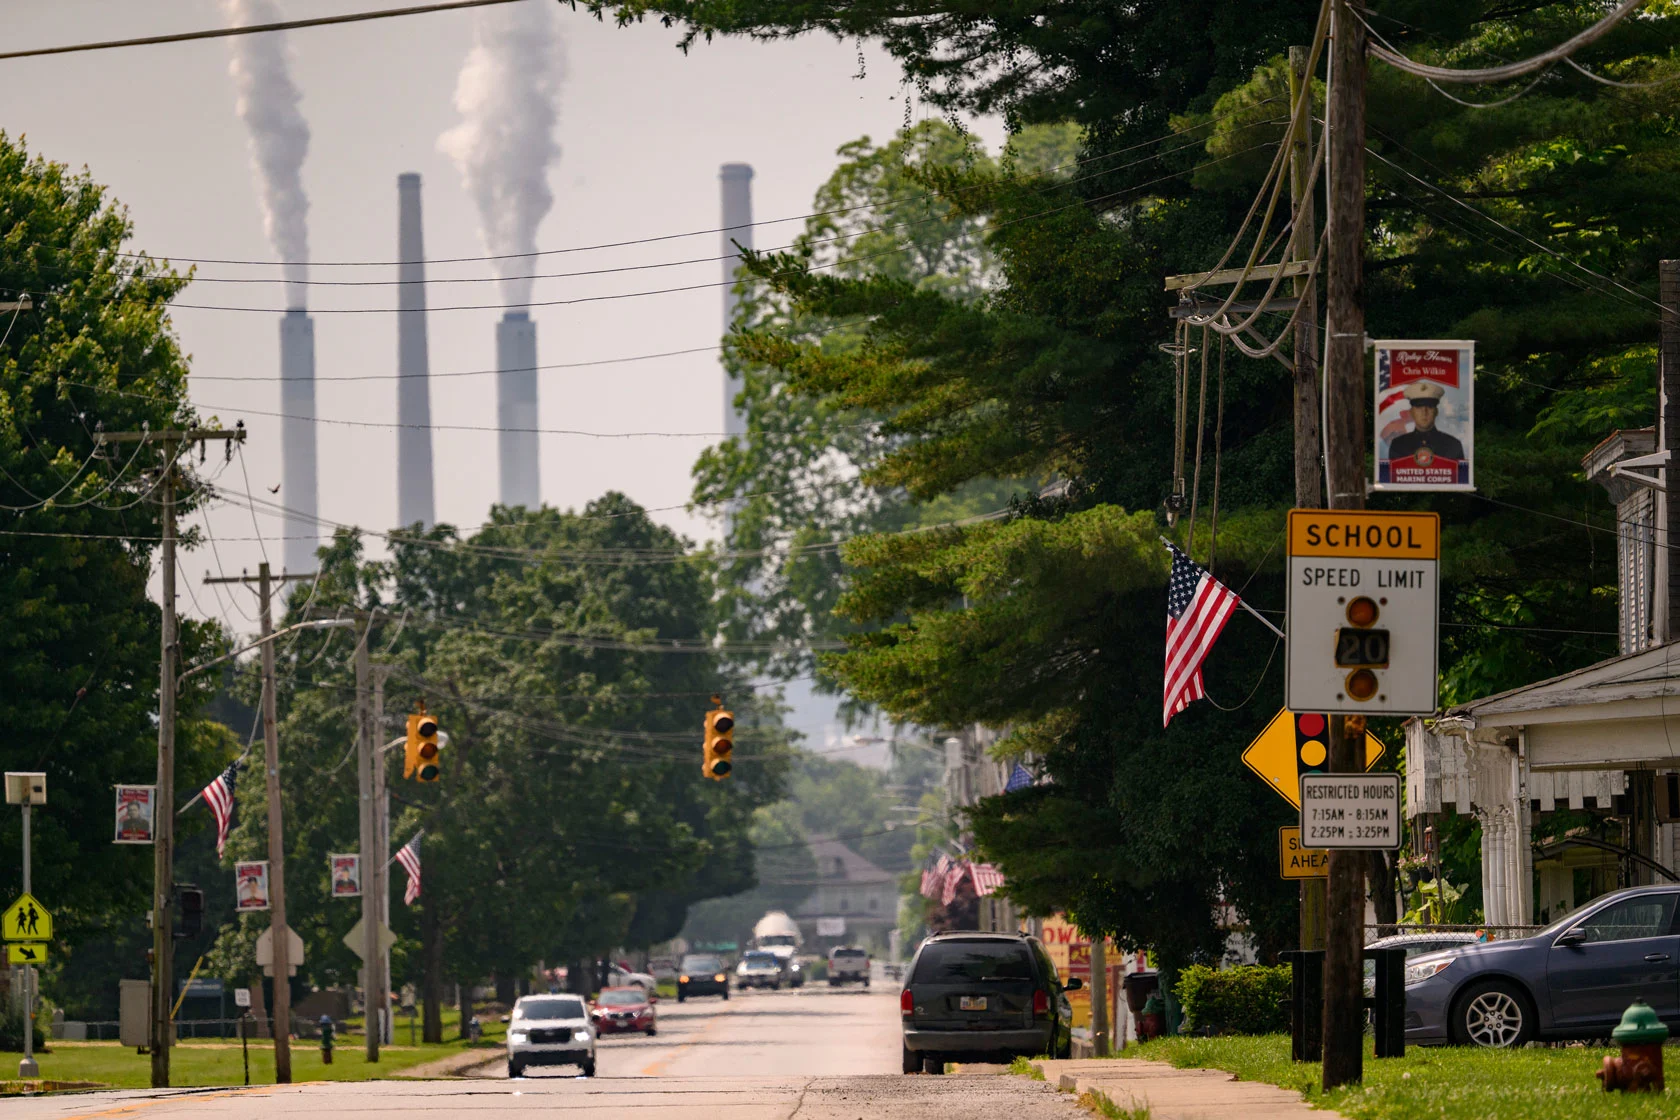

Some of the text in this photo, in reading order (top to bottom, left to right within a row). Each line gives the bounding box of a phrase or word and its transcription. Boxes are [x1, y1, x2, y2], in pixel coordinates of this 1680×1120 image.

[1402, 367, 1421, 375] Chris
[1306, 524, 1421, 548] SCHOOL
[1303, 567, 1424, 588] SPEED LIMIT
[1340, 635, 1386, 664] 20
[1307, 785, 1394, 799] RESTRICTED HOURS
[1312, 809, 1344, 820] 7:15AM
[1356, 809, 1388, 820] 8:15AM
[1311, 826, 1344, 838] 2:25PM
[1356, 826, 1389, 838] 3:25PM
[1290, 855, 1328, 868] AHEA
